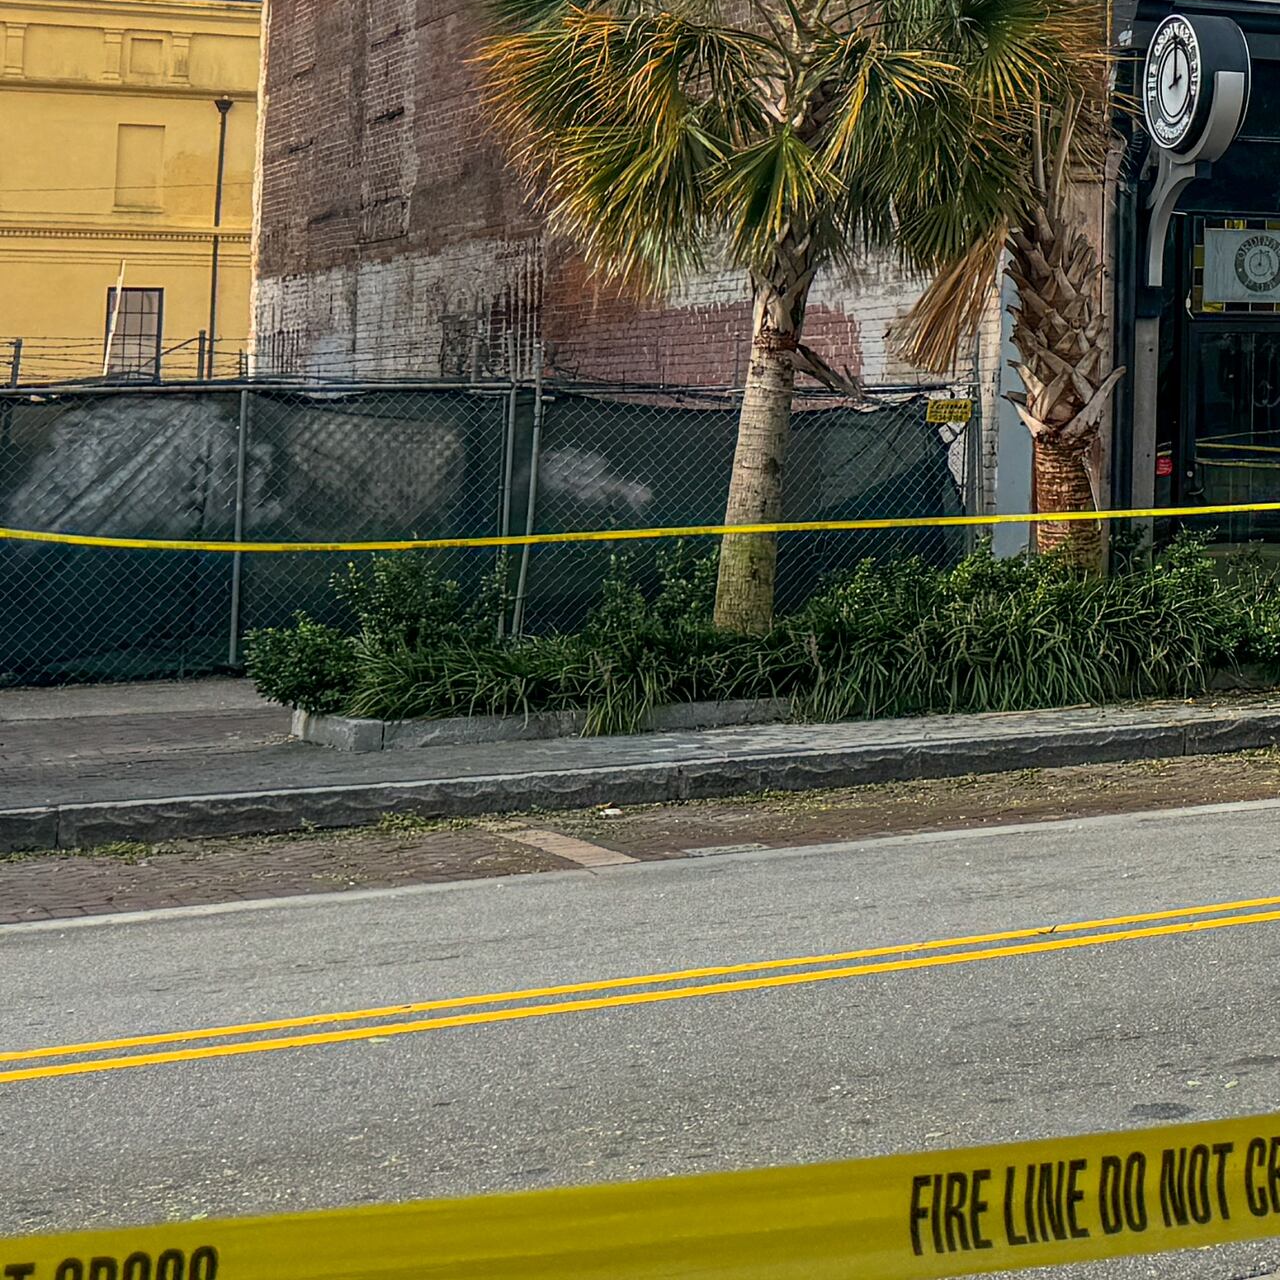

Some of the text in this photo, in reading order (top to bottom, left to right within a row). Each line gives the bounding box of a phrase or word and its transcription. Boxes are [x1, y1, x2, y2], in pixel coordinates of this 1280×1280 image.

[909, 1168, 993, 1257] FIRE
[1003, 1158, 1090, 1246] LINE
[1098, 1150, 1147, 1235] DO
[1159, 1141, 1234, 1229] NOT
